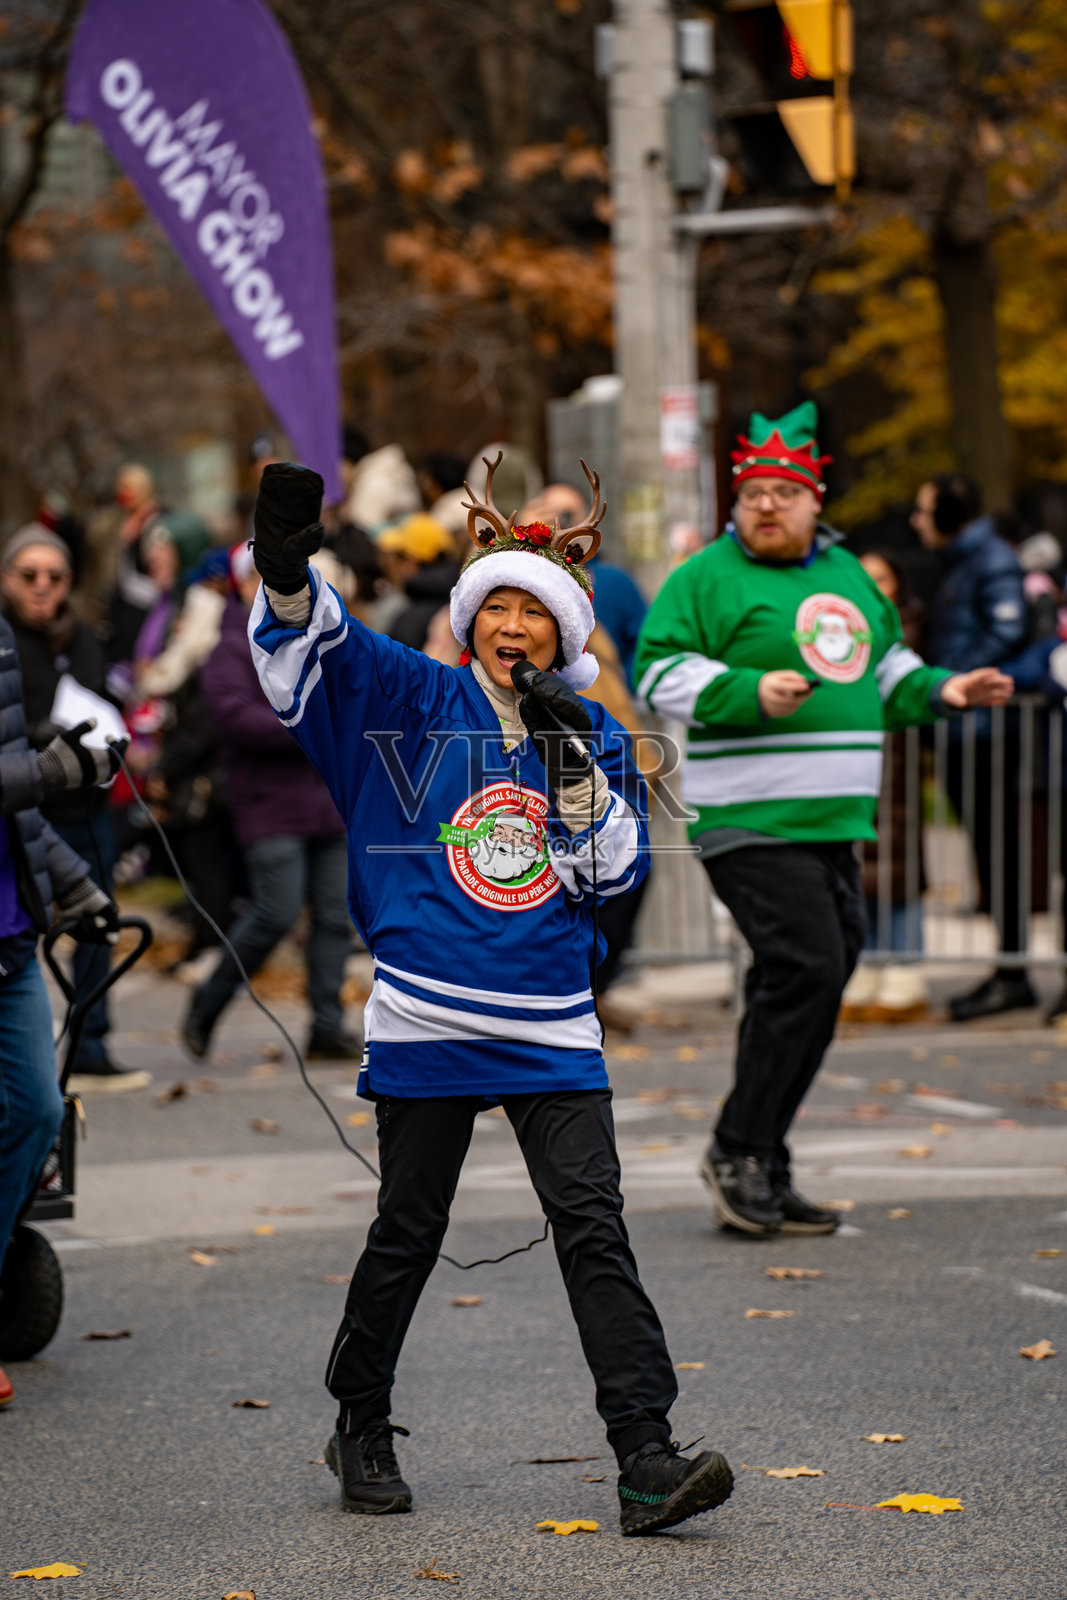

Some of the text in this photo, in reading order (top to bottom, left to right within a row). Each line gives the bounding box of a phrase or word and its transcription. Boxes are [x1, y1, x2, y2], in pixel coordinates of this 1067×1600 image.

[101, 58, 304, 360] OLIVIA CHOW
[174, 99, 285, 259] MAYOR
[461, 790, 548, 827] THE ORIGINAL SANT CLAUS
[455, 849, 558, 904] LA PARADE ORIGINALE DU PÈRE NOË
